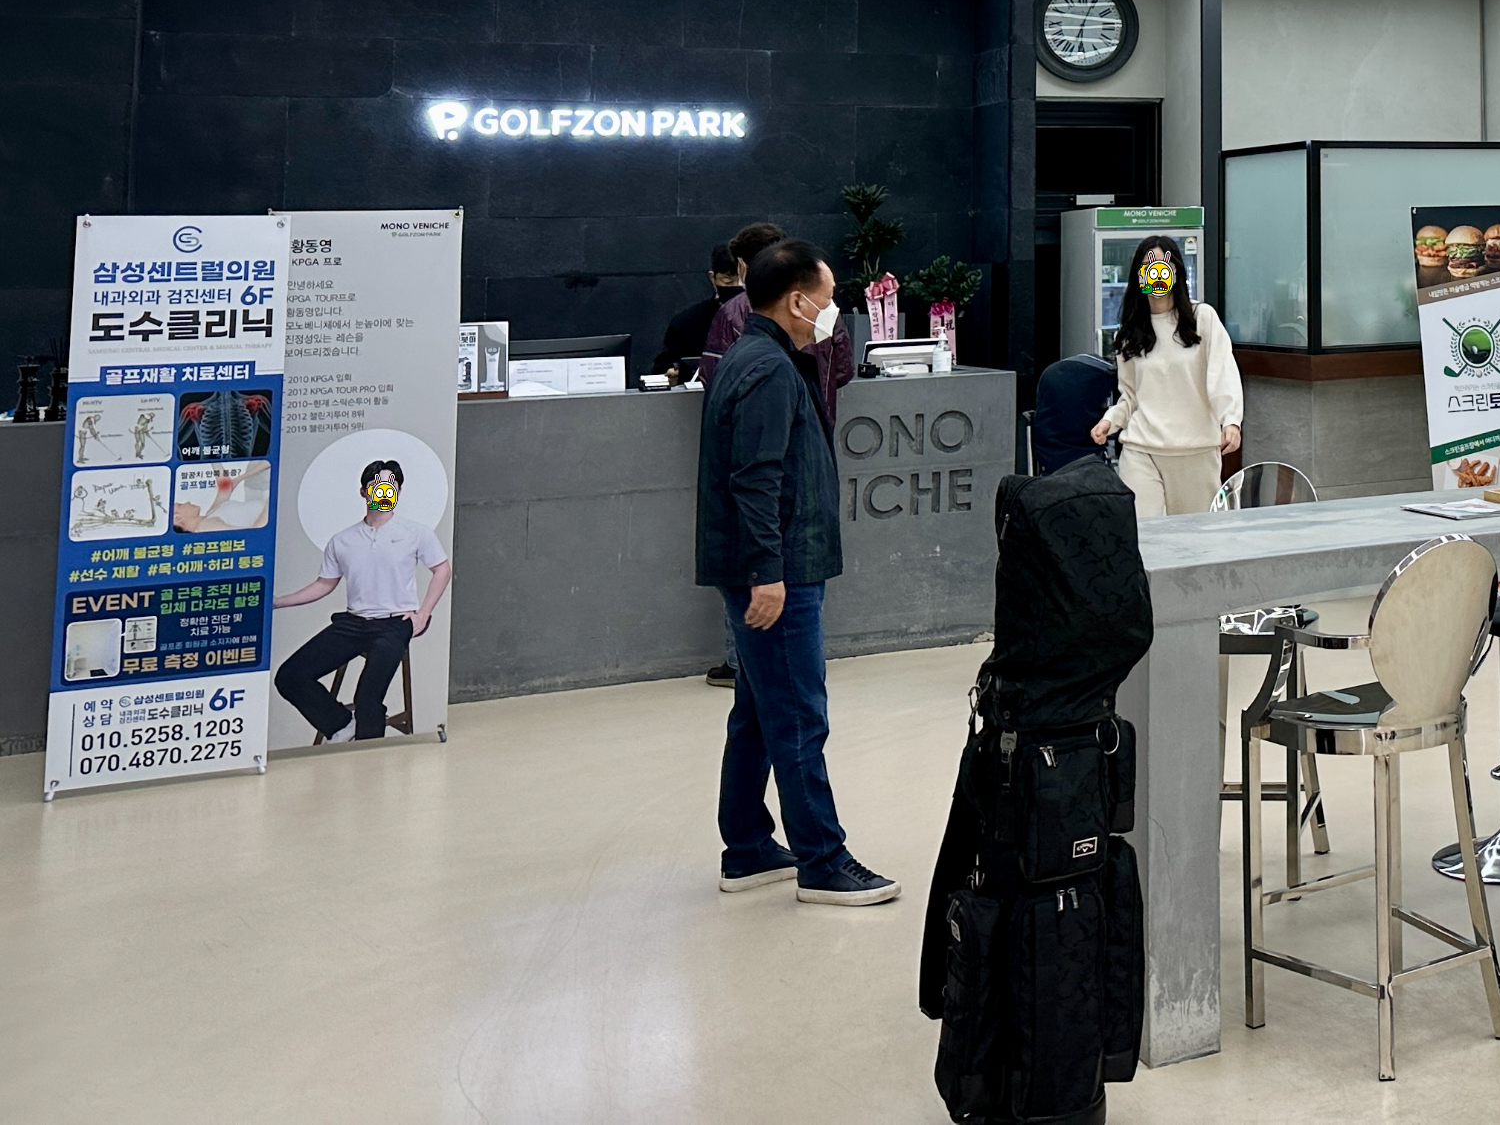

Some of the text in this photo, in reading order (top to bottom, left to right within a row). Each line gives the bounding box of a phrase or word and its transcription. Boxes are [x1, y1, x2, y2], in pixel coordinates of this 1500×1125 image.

[473, 108, 747, 138] GOLFZON PARK
[1148, 209, 1177, 217] VENICHE
[380, 222, 450, 230] MONO VENICHE
[291, 239, 332, 253] 황동영
[292, 257, 342, 266] KPGA 프로
[93, 259, 276, 284] 삼성센트럴의원
[287, 280, 334, 290] 안녕하세요
[93, 285, 274, 306] 내과외과 검진센터 6F
[287, 293, 356, 303] KPGA TOUR프로
[89, 308, 274, 342] 도수클리닉
[355, 318, 392, 329] 눈높이에
[396, 317, 415, 327] 맞는
[285, 333, 364, 344] 진정성있는 레슨을
[245, 342, 273, 350] THERAPY
[105, 365, 250, 385] 골프재활 치료센터
[310, 375, 334, 383] KPGA
[336, 373, 352, 382] 입회
[287, 384, 394, 396] 2012 KPGA TOUR PRO 입회
[373, 397, 389, 406] 활동
[286, 413, 307, 421] 2012
[839, 410, 974, 460] ONO
[181, 444, 231, 456] 어깨 불균형
[180, 471, 204, 480] 팔꿈치
[205, 470, 221, 478] 안쪽
[179, 479, 217, 490] 골프엘보
[847, 468, 973, 522] ICHE
[91, 539, 246, 563] #어깨 불균형 #골프엘보
[69, 567, 108, 583] #선수
[112, 565, 140, 579] 재활
[238, 555, 264, 568] 통증
[178, 586, 203, 599] 근육
[206, 584, 232, 597] 조직
[236, 581, 261, 594] 내부
[72, 591, 155, 614] EVENT
[160, 594, 260, 615] 입체 다각도 촬영
[179, 613, 243, 627] 정확한 진단 및
[190, 624, 231, 637] 치료 가능
[210, 637, 240, 647] 소지자에
[241, 634, 257, 644] 한해
[122, 647, 257, 674] 무료 측정 이벤트
[133, 689, 205, 705] 삼성센트럴의원
[209, 687, 246, 712] 6F
[147, 703, 204, 721] 도수클리닉
[81, 717, 244, 752] 010.5258.1203
[80, 739, 242, 775] 070.4870.2275
